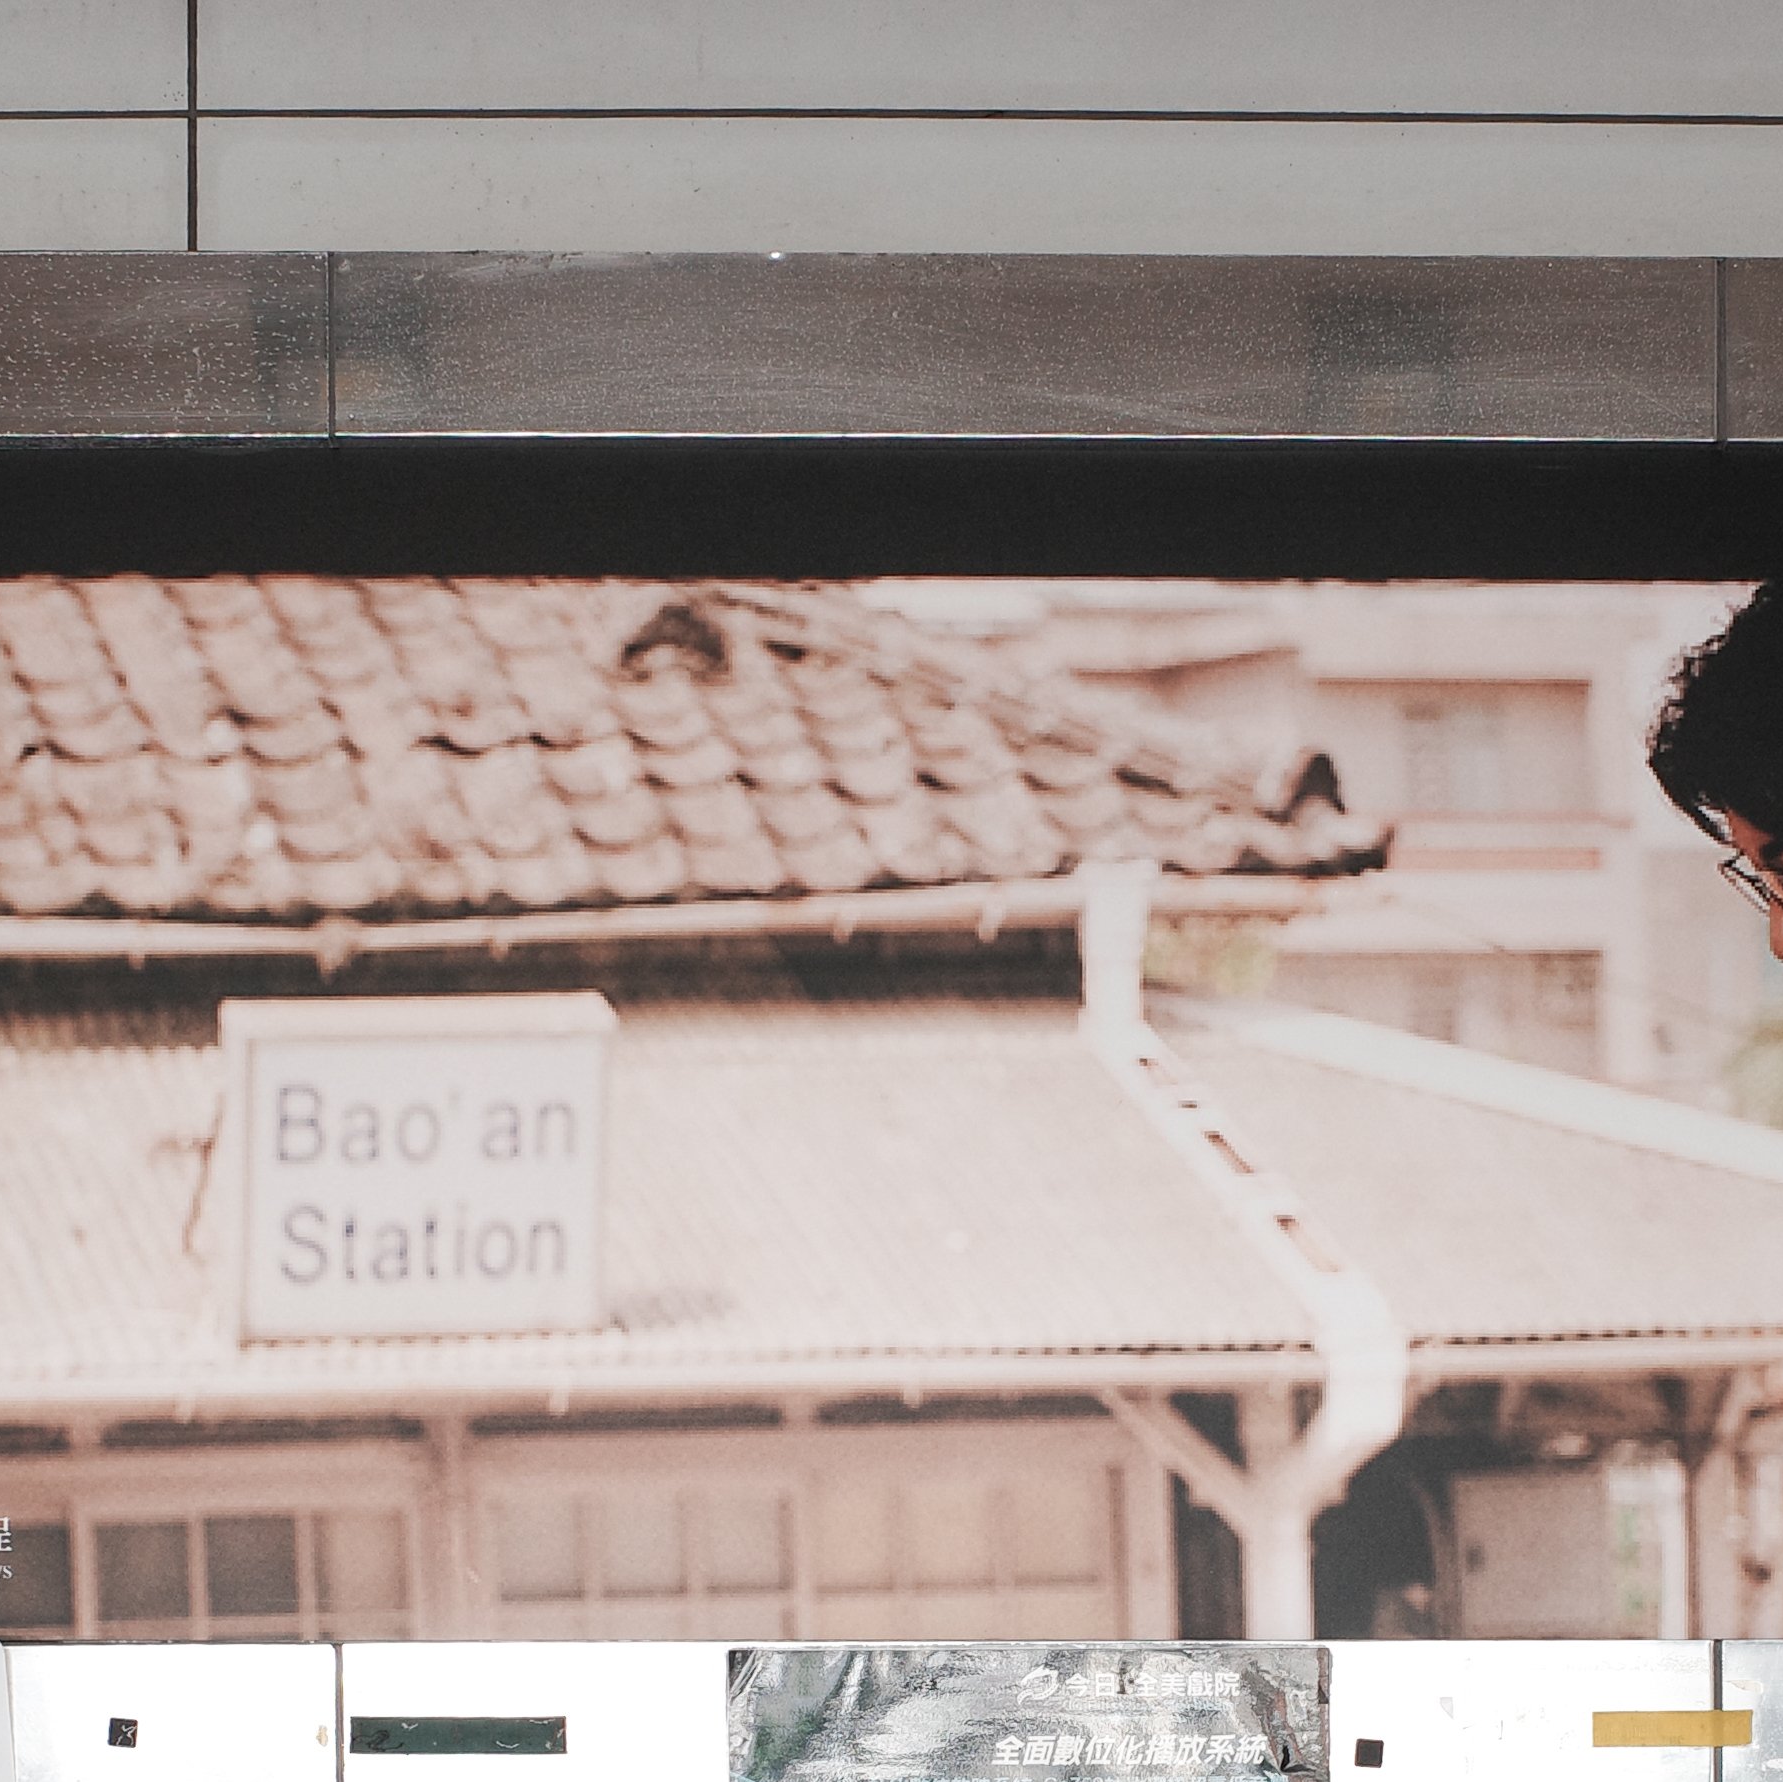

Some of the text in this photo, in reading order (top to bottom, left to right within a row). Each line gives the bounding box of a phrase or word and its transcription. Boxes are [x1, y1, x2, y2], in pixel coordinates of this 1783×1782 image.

[277, 1083, 576, 1164] Bao'an
[280, 1200, 567, 1286] Station
[1131, 1670, 1241, 1699] 全美戲院
[991, 1734, 1268, 1768] 全面數位化播放系統
